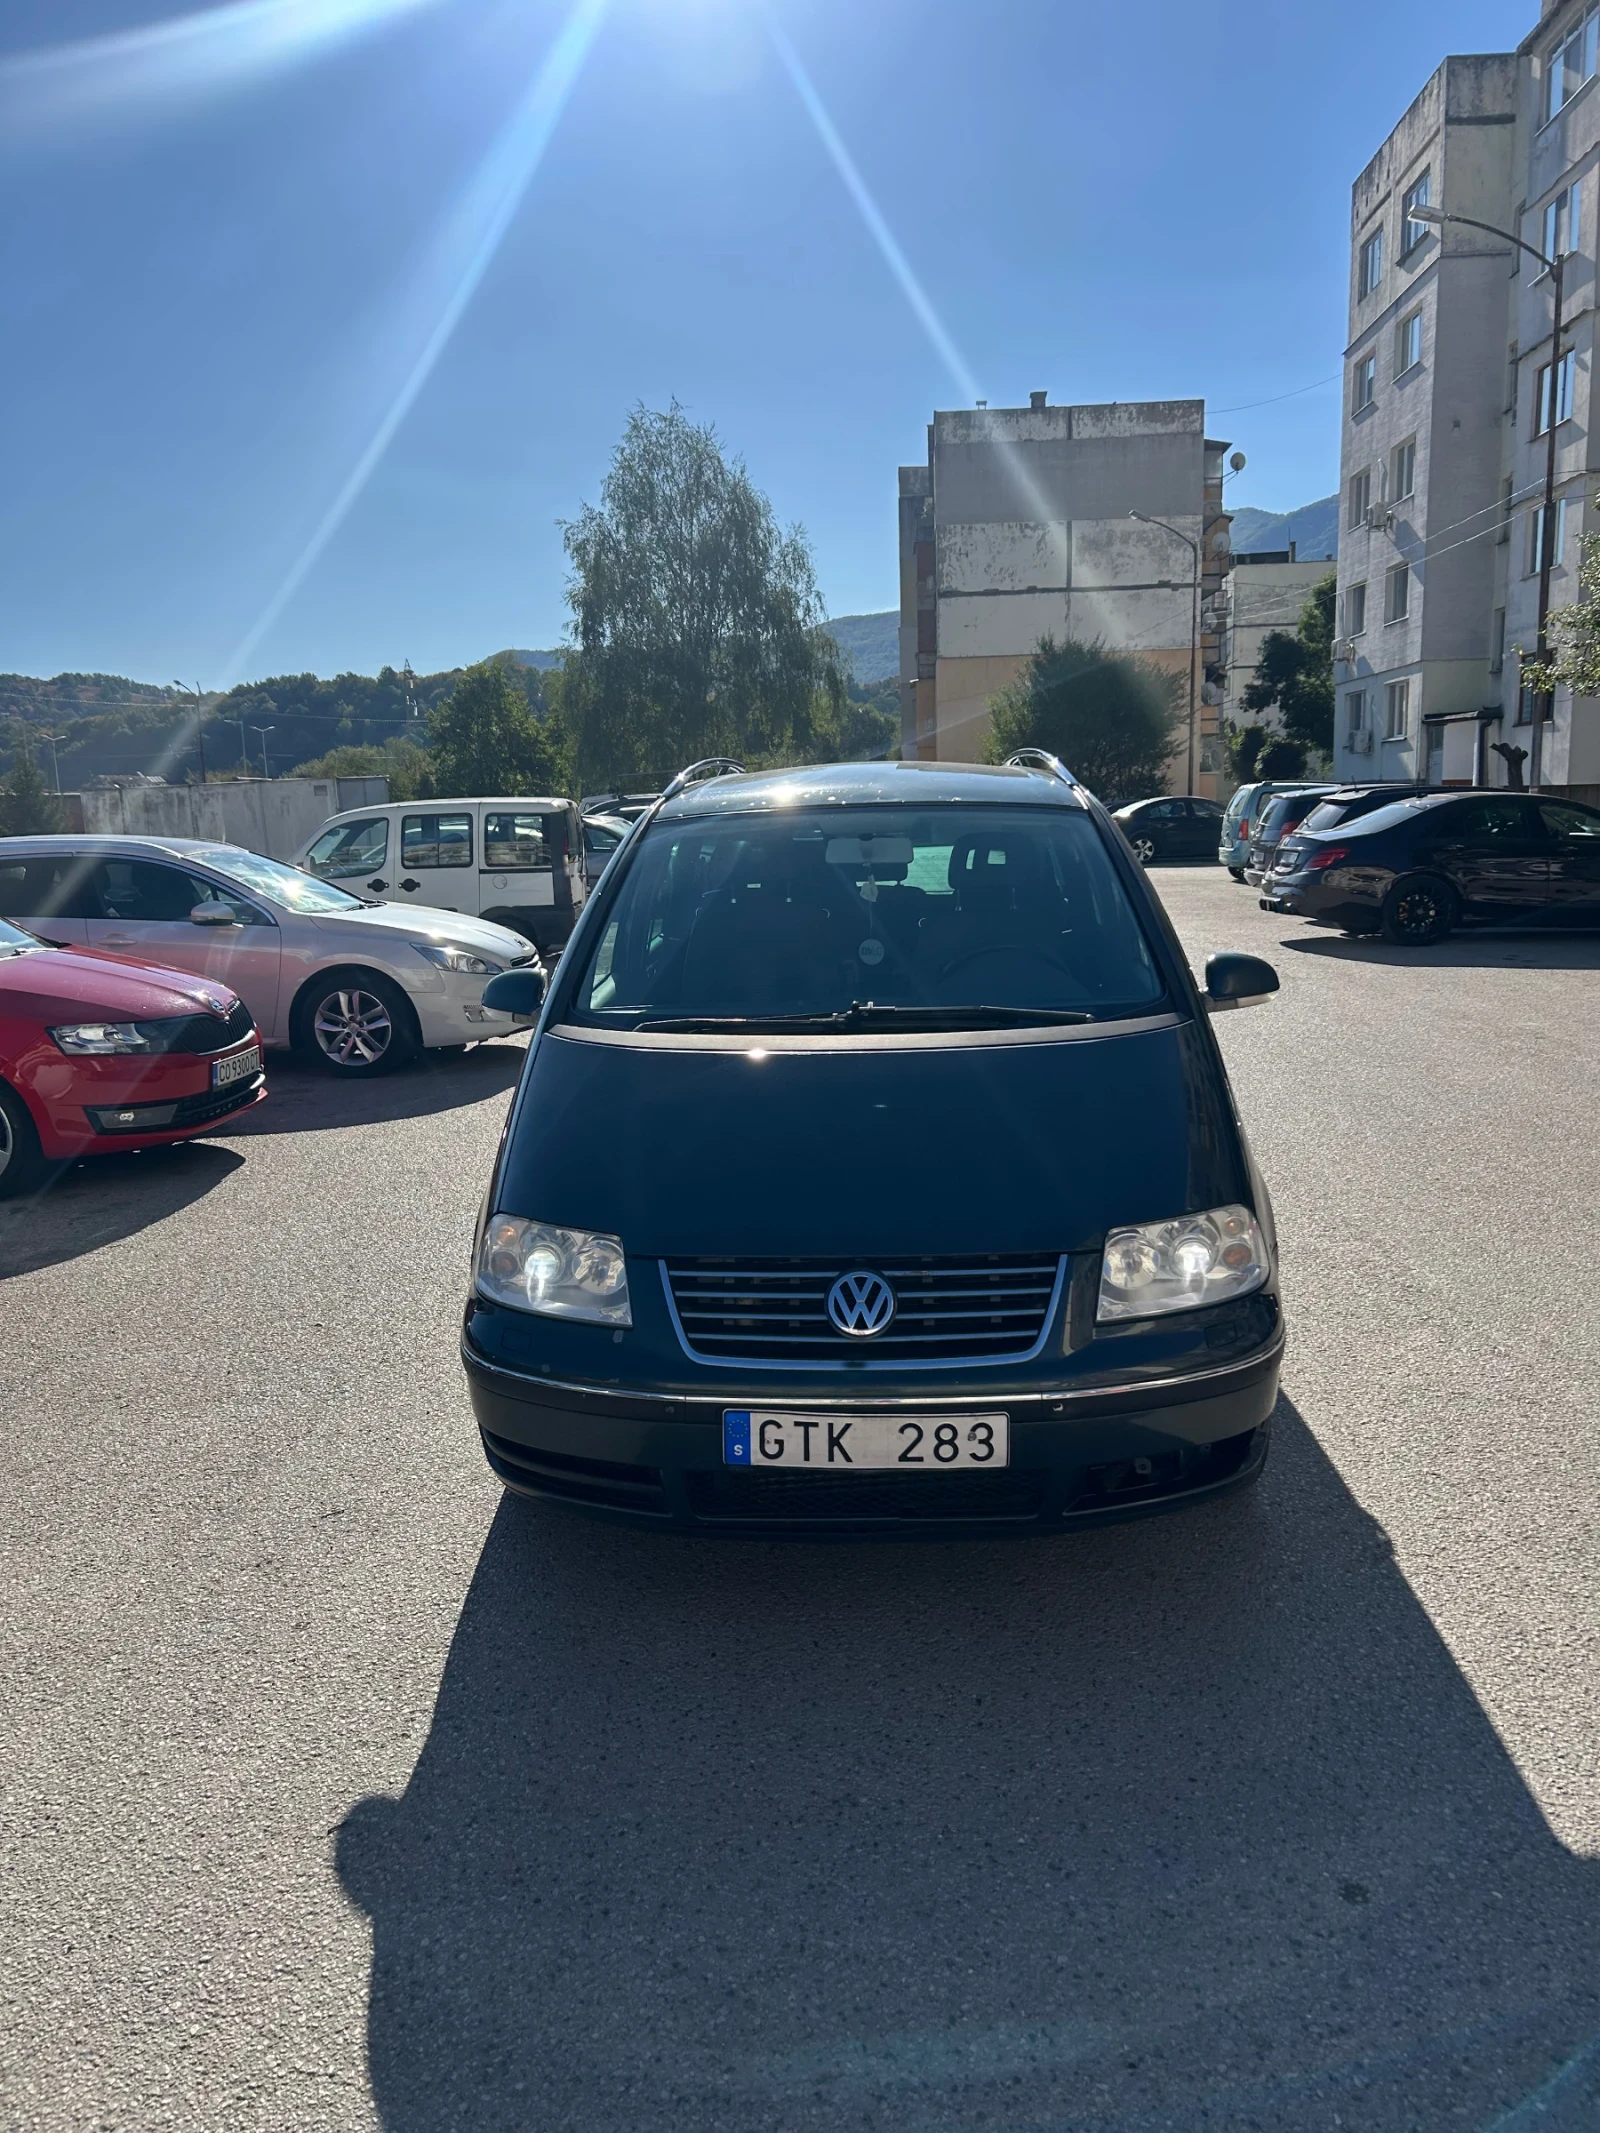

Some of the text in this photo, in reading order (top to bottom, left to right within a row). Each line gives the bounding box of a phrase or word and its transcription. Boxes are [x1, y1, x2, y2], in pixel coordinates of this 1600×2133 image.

[219, 1064, 231, 1082] CO
[733, 1419, 995, 1463] S GTK 283
